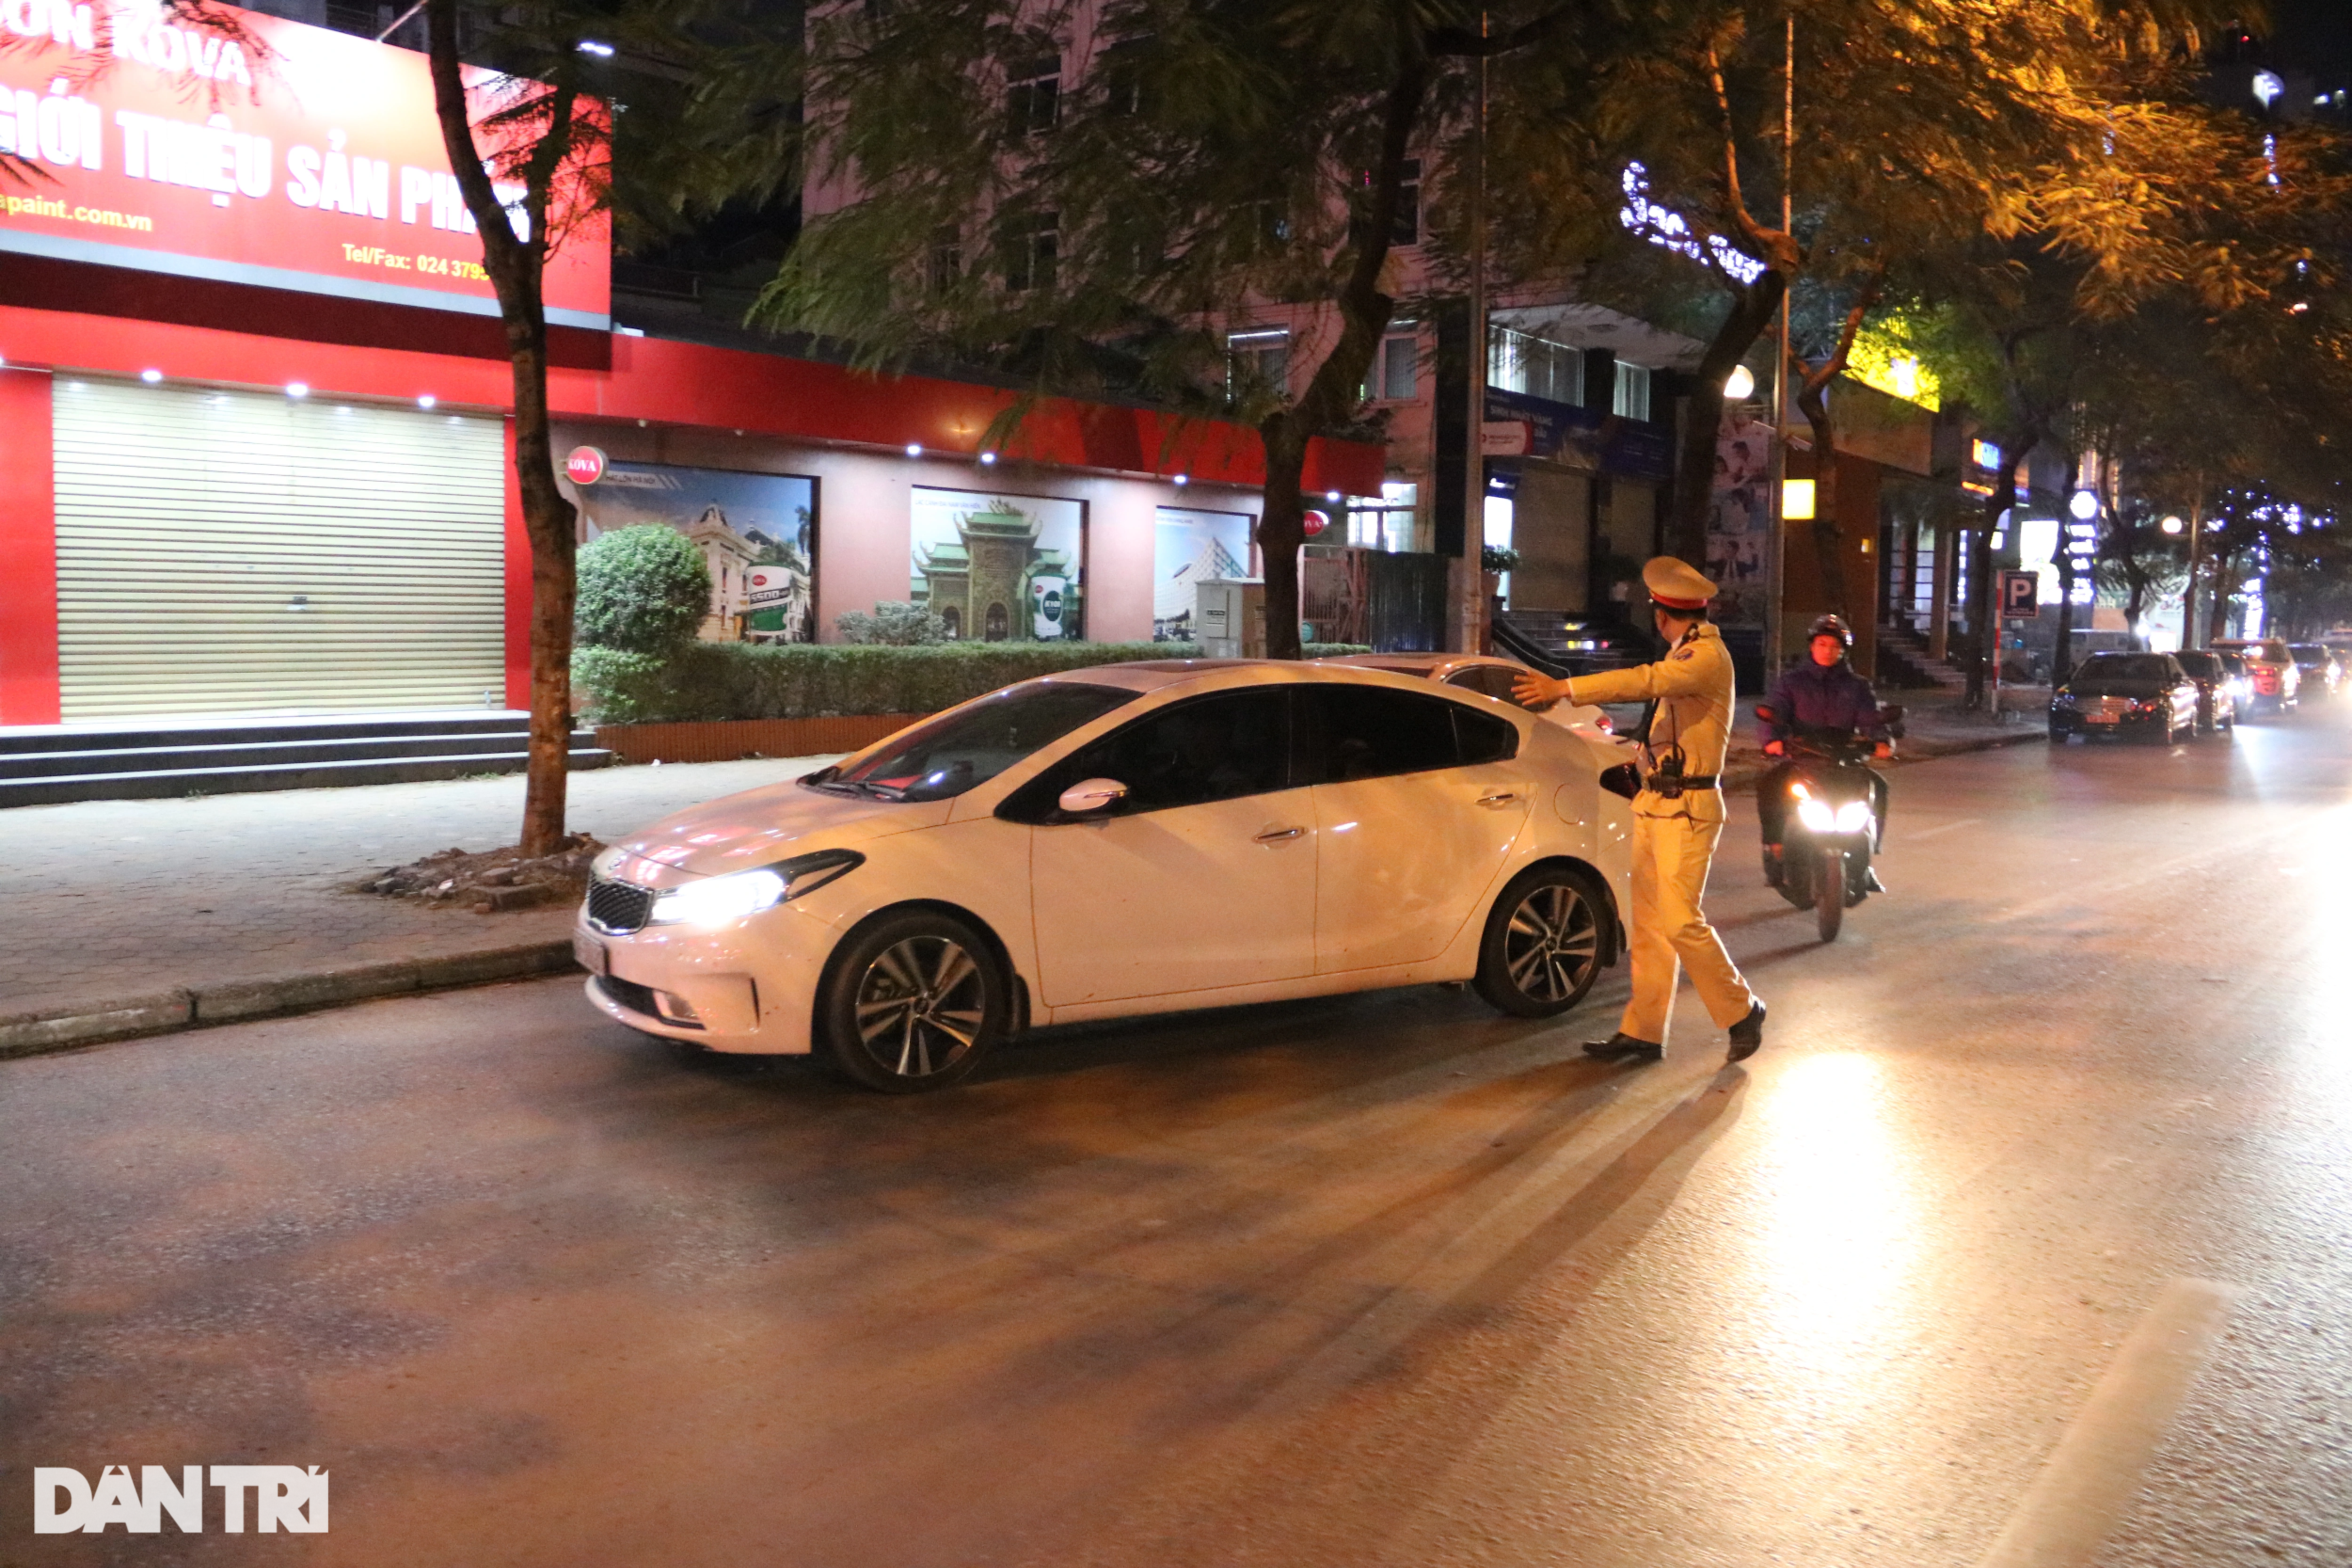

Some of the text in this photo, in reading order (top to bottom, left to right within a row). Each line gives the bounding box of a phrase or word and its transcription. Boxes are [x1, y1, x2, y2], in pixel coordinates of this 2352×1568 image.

[112, 13, 251, 86] KOVA
[116, 113, 272, 207] THIỆU
[286, 128, 389, 220] SẢN
[342, 243, 411, 270] Tel/Fax:
[417, 255, 449, 275] 024
[2010, 579, 2031, 606] P
